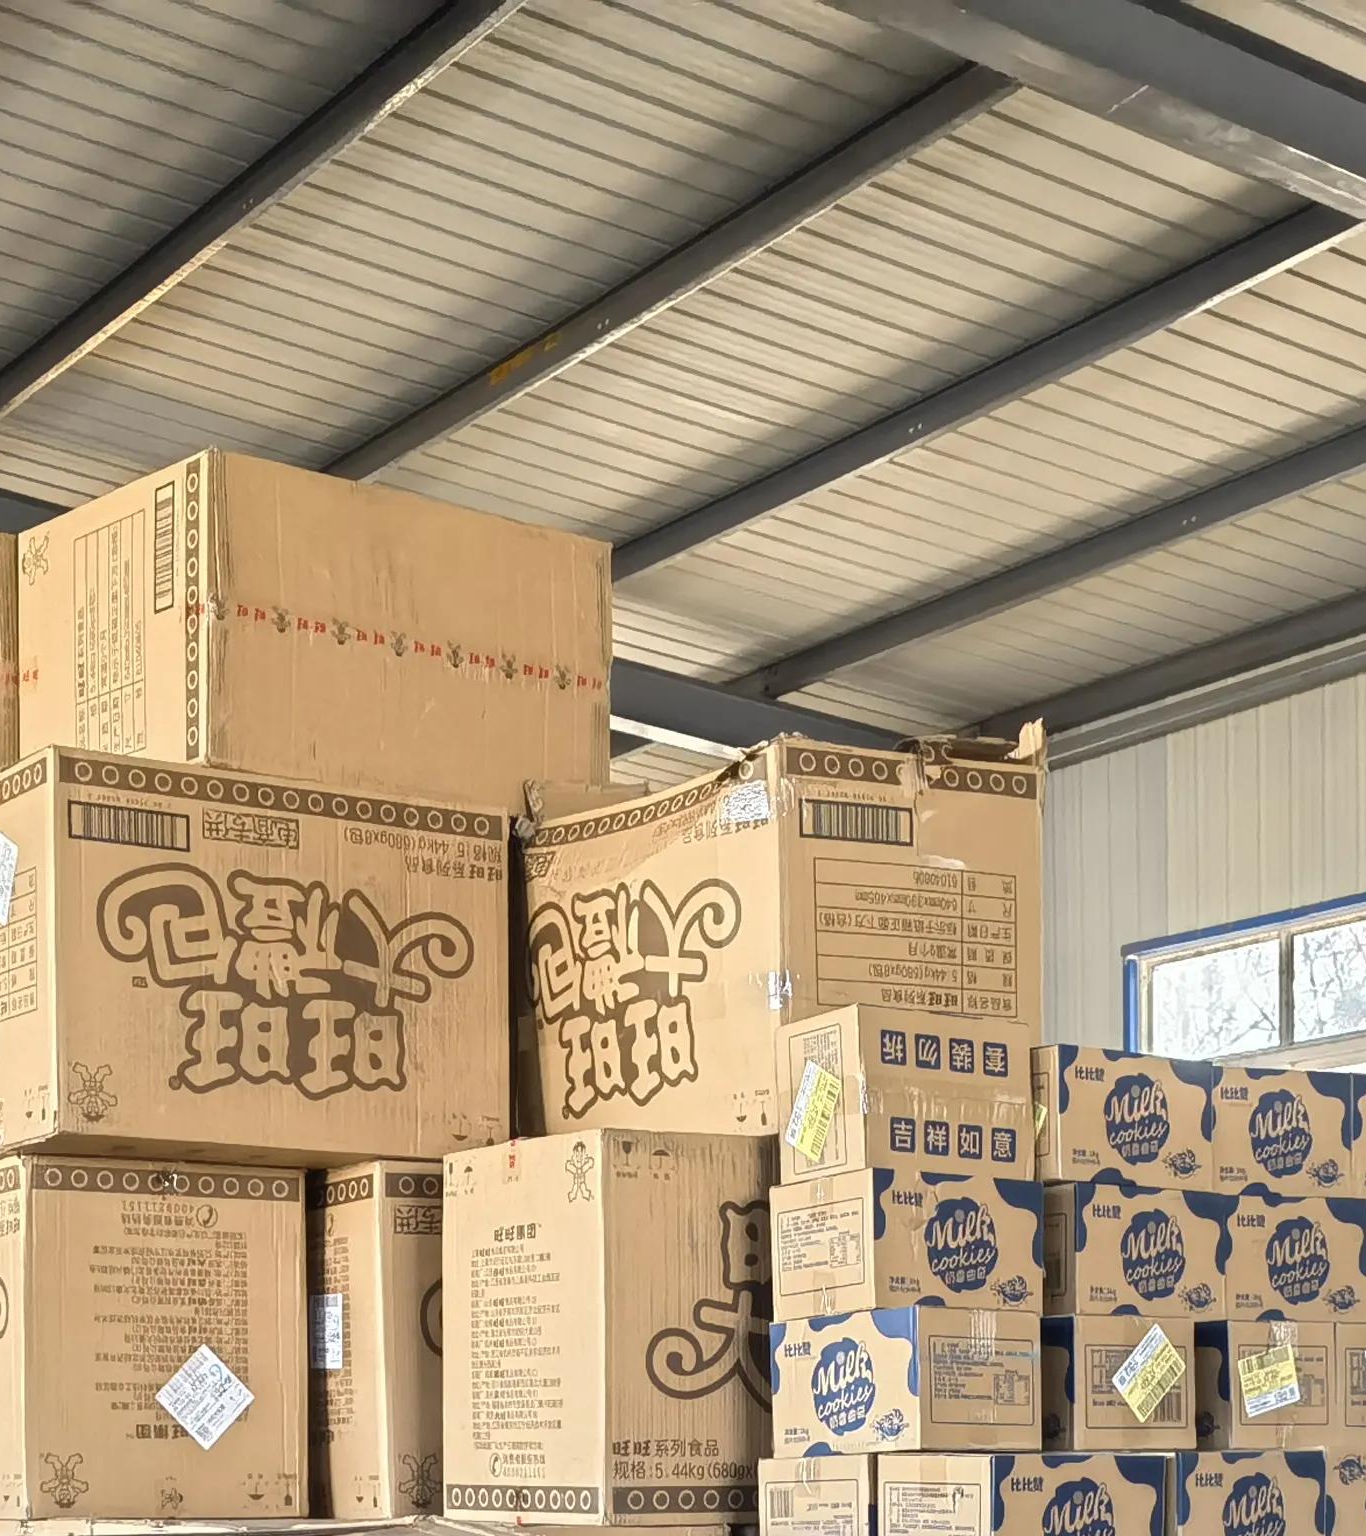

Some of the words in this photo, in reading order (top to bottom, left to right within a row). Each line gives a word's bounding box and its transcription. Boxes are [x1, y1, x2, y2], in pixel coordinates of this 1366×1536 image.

[202, 809, 299, 849] 电商专供
[406, 855, 502, 882] 旺旺系列食品
[967, 925, 1012, 940] 生产日期
[881, 988, 958, 1006] 旺旺系列食品
[967, 994, 1011, 1012] 食品名称
[170, 987, 407, 1099] 旺旺
[562, 996, 698, 1119] 旺旺
[1106, 1080, 1167, 1123] Milk
[1250, 1095, 1310, 1138] Milk
[891, 1118, 1015, 1162] 吉祥如意
[1109, 1120, 1169, 1147] cookies
[1254, 1135, 1310, 1161] cookies
[494, 1225, 536, 1241] 旺旺集团
[929, 1204, 994, 1249] Milk
[1123, 1215, 1182, 1261] Milk
[1268, 1223, 1328, 1265] Milk
[931, 1246, 994, 1273] cookies
[1126, 1256, 1185, 1282] cookies
[1272, 1261, 1329, 1287] cookies
[814, 1340, 874, 1394] Milk
[817, 1387, 873, 1419] cookies
[612, 1438, 719, 1458] 旺旺系列食品
[1043, 1482, 1115, 1531] Milk
[1224, 1477, 1284, 1528] Milk
